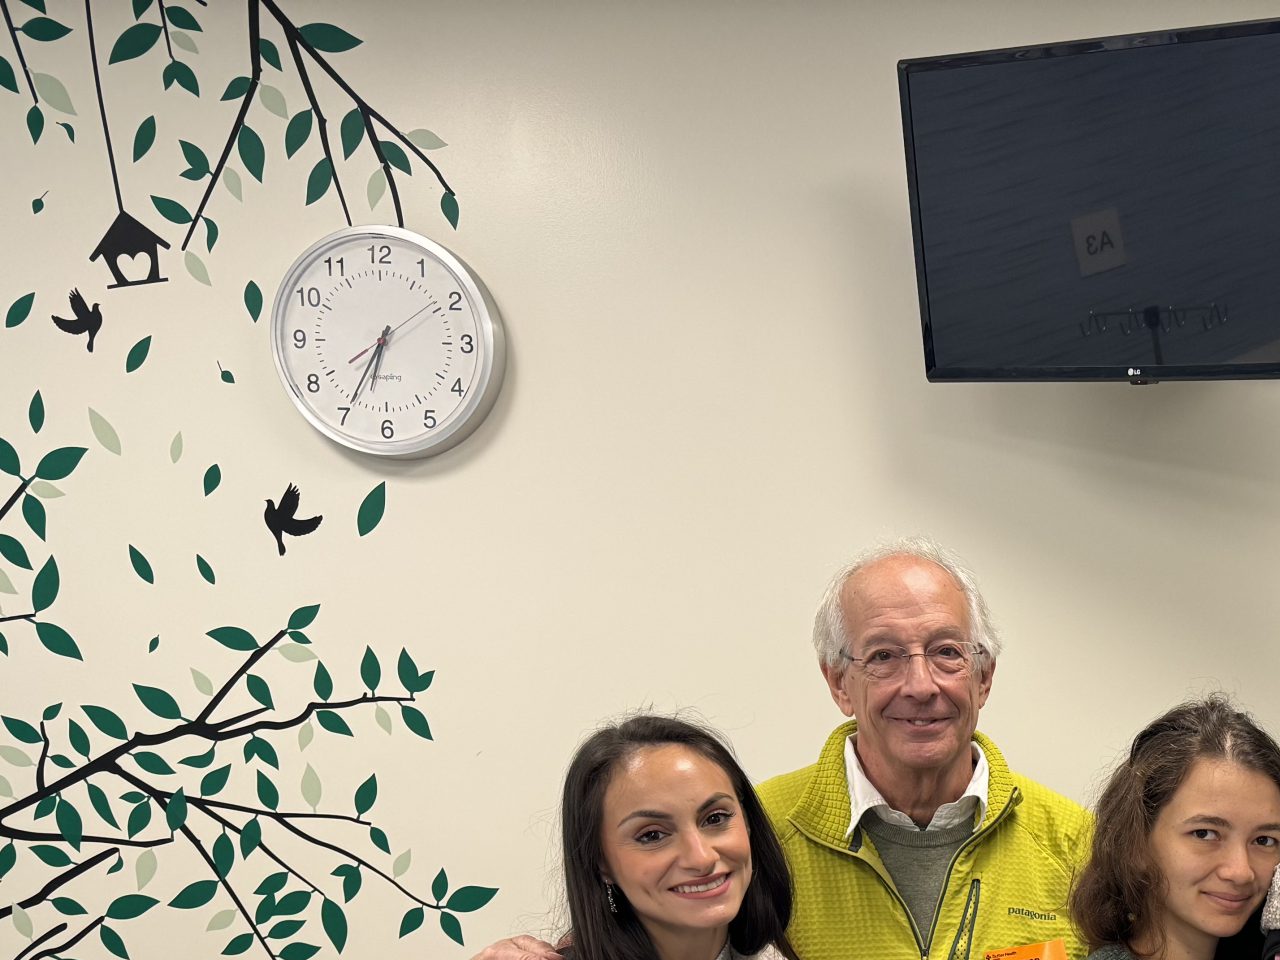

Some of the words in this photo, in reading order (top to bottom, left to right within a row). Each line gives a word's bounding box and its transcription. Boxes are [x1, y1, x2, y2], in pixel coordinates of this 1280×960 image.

[367, 245, 392, 264] 12
[324, 257, 345, 276] 11
[416, 258, 425, 278] 1
[296, 287, 321, 307] 10
[448, 291, 463, 311] 2
[293, 329, 307, 349] 9
[460, 334, 474, 354] 3
[306, 374, 320, 393] 8
[450, 377, 465, 397] 4
[337, 406, 351, 426] 7
[423, 410, 437, 429] 5
[380, 419, 394, 439] 6
[1008, 907, 1056, 921] patagonia
